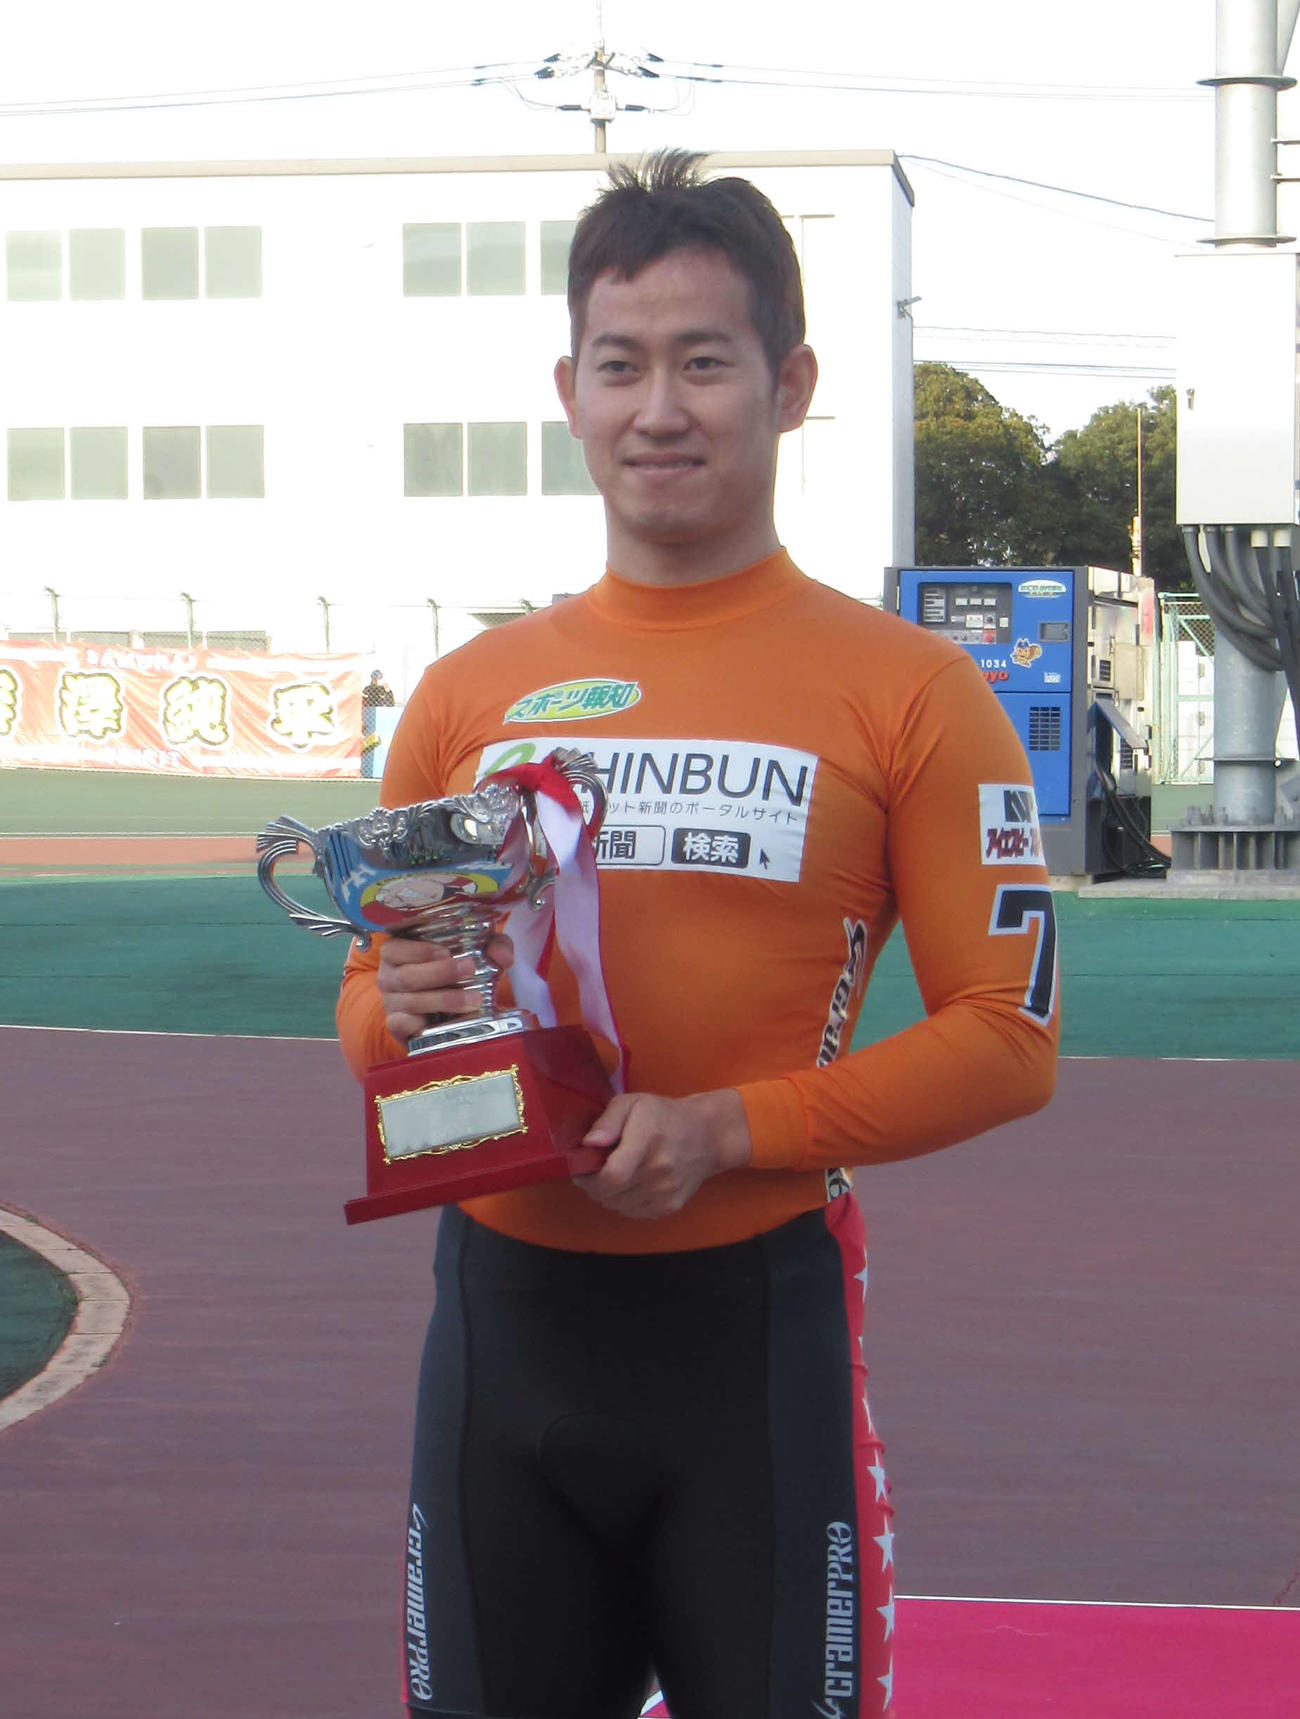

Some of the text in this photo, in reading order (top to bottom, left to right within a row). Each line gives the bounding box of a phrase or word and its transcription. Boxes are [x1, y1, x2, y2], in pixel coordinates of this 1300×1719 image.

[980, 659, 1007, 668] 1034
[505, 683, 634, 719] スポーツ報知
[581, 752, 808, 807] HINBUN
[582, 800, 799, 825] ット新聞のポータルサイト
[683, 832, 739, 863] 検索
[988, 884, 1056, 1027] 7
